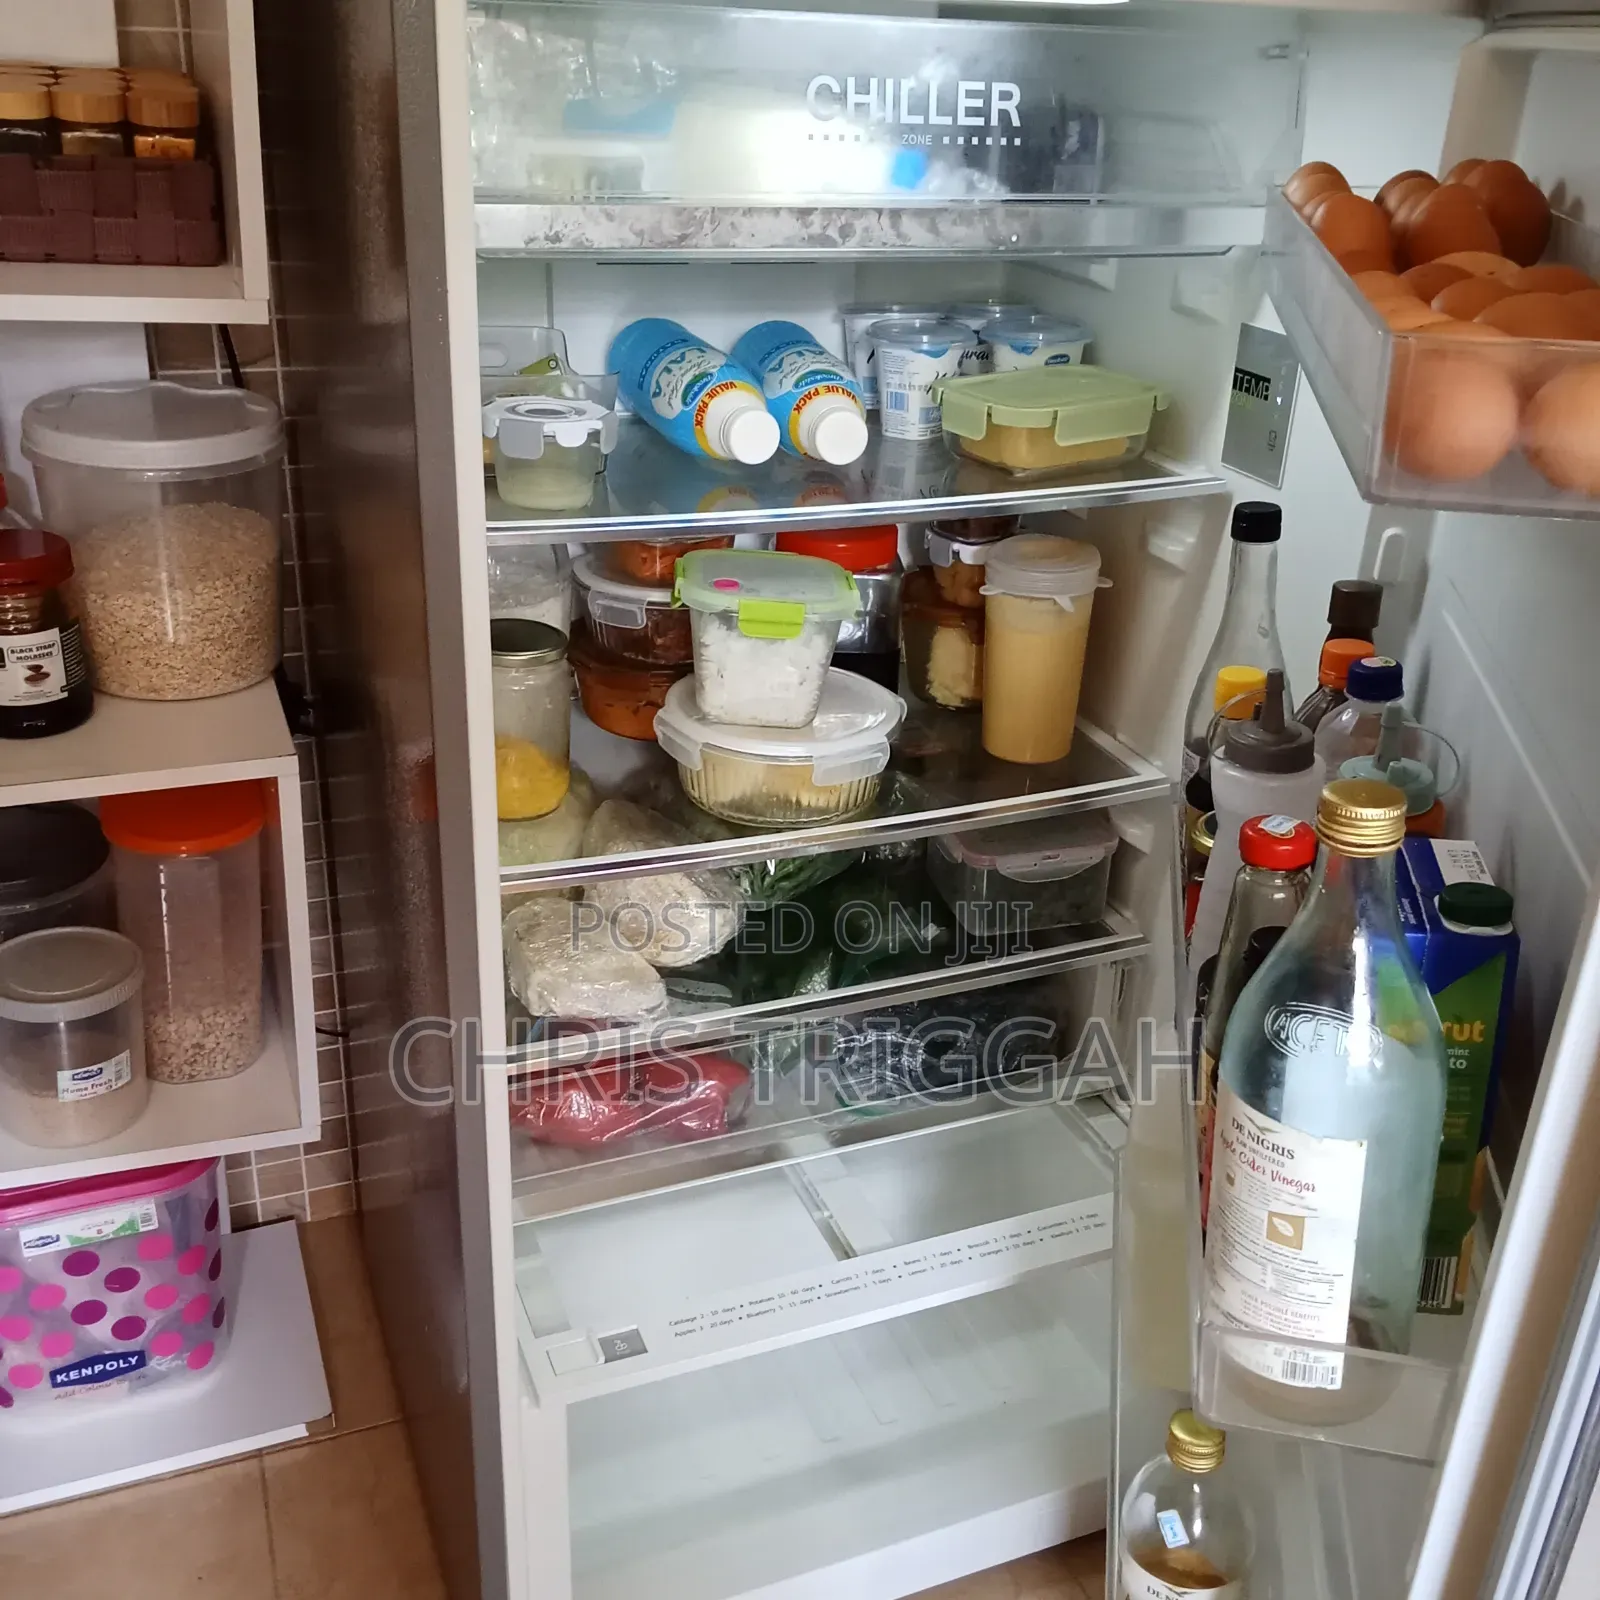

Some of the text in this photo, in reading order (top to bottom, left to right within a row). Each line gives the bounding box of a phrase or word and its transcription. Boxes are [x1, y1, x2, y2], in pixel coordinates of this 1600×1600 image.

[806, 74, 1021, 127] CHILLER
[902, 134, 932, 145] ZONE
[695, 382, 737, 428] VALUE PACK
[792, 385, 858, 414] VALUE PACK
[16, 650, 54, 661] MOLASSES
[91, 1078, 113, 1090] Fresh
[1232, 1117, 1245, 1136] DE
[1246, 1132, 1296, 1161] NIGRIS
[1238, 1152, 1266, 1176] Cider
[1270, 1169, 1316, 1194] Vinegar
[718, 1317, 733, 1326] days
[721, 1305, 736, 1314] days
[56, 1355, 139, 1383] KENPOLY
